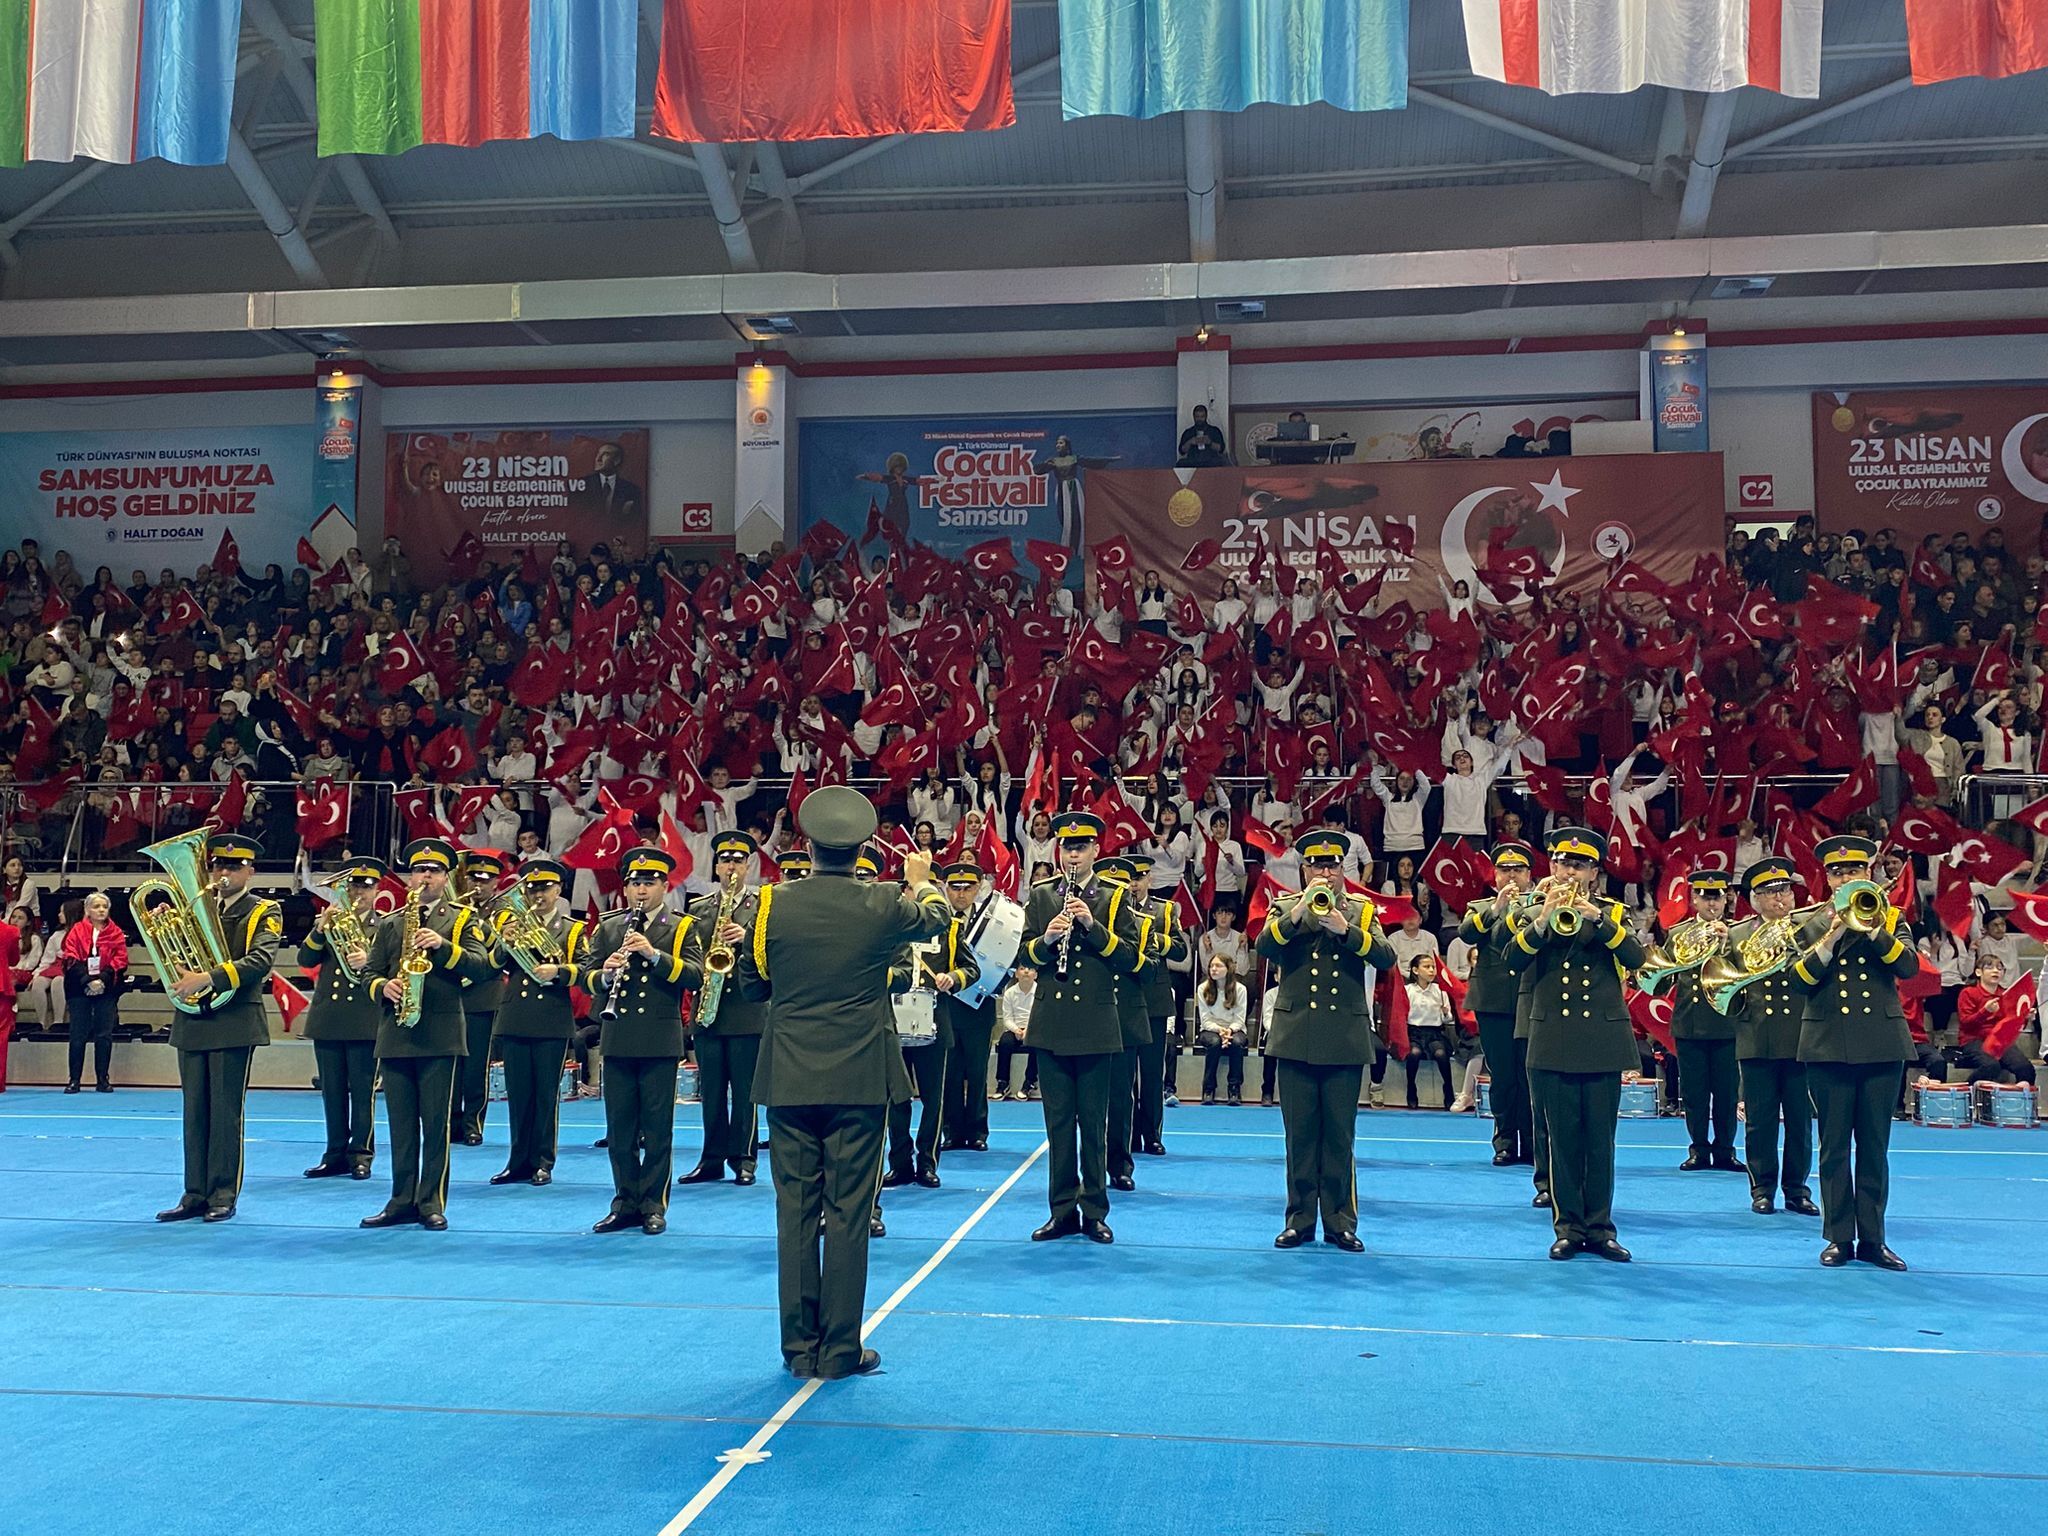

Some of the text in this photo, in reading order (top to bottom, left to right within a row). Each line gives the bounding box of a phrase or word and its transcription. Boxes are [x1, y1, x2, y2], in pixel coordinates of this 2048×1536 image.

[56, 447, 260, 462] TÜRK DÜNYASI'NIN BULUŞMA NOKTASI
[1849, 433, 1992, 463] 23 NİSAN
[462, 457, 491, 479] 23
[935, 446, 1036, 482] Çocuk
[1848, 461, 1991, 477] ULUSAL EGEMENLİK VE
[38, 463, 275, 491] SAMSUN'UMUZA
[1855, 476, 1988, 493] ÇOCUK BAYRAMIMIZ
[920, 476, 1047, 507] Festivali
[1741, 481, 1773, 501] C2
[55, 487, 256, 521] HOŞ GELDİNİZ
[684, 508, 712, 527] C3
[938, 507, 1029, 527] Samsun
[161, 526, 204, 538] DOĞAN
[521, 530, 566, 542] DOĞAN
[1221, 518, 1270, 549] 23
